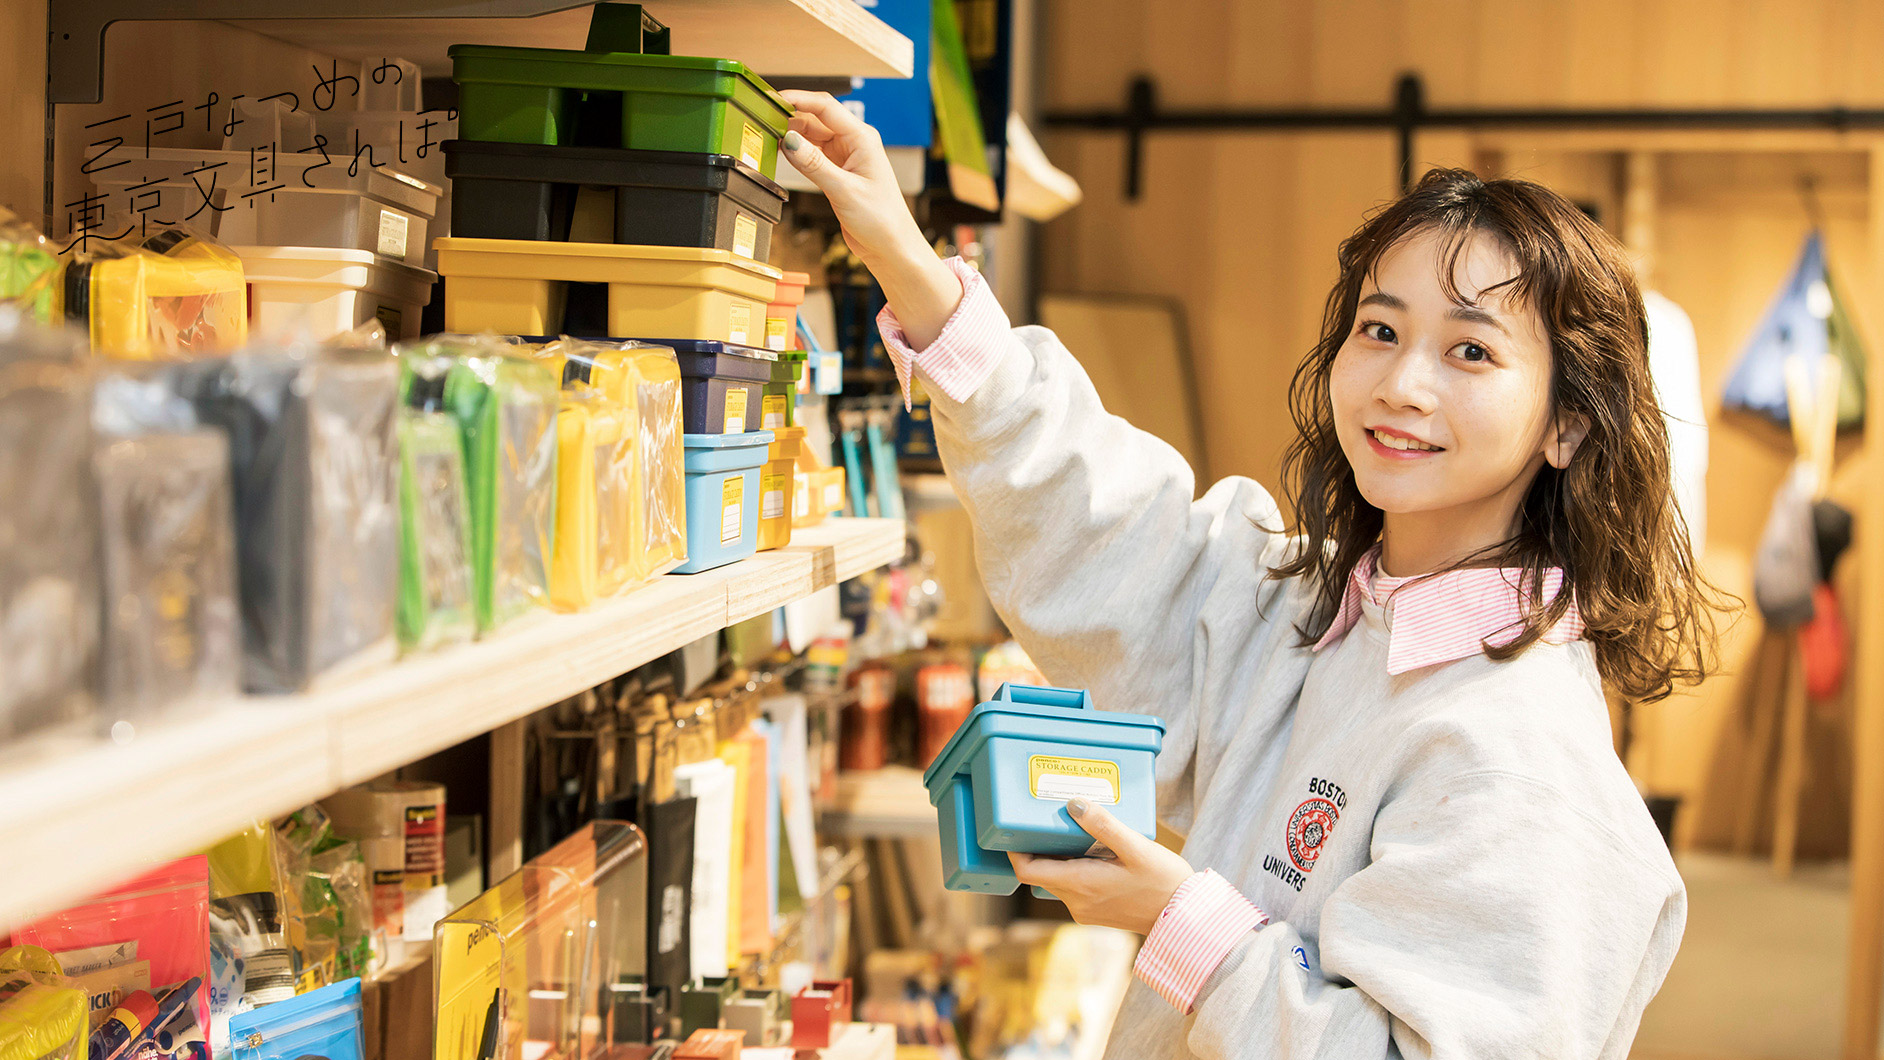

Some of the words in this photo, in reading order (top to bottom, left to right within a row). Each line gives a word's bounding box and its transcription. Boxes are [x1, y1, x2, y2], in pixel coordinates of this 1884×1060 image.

[1035, 762, 1079, 772] STORAGE
[1080, 765, 1113, 775] CADDY
[1263, 854, 1307, 892] UNIVERS
